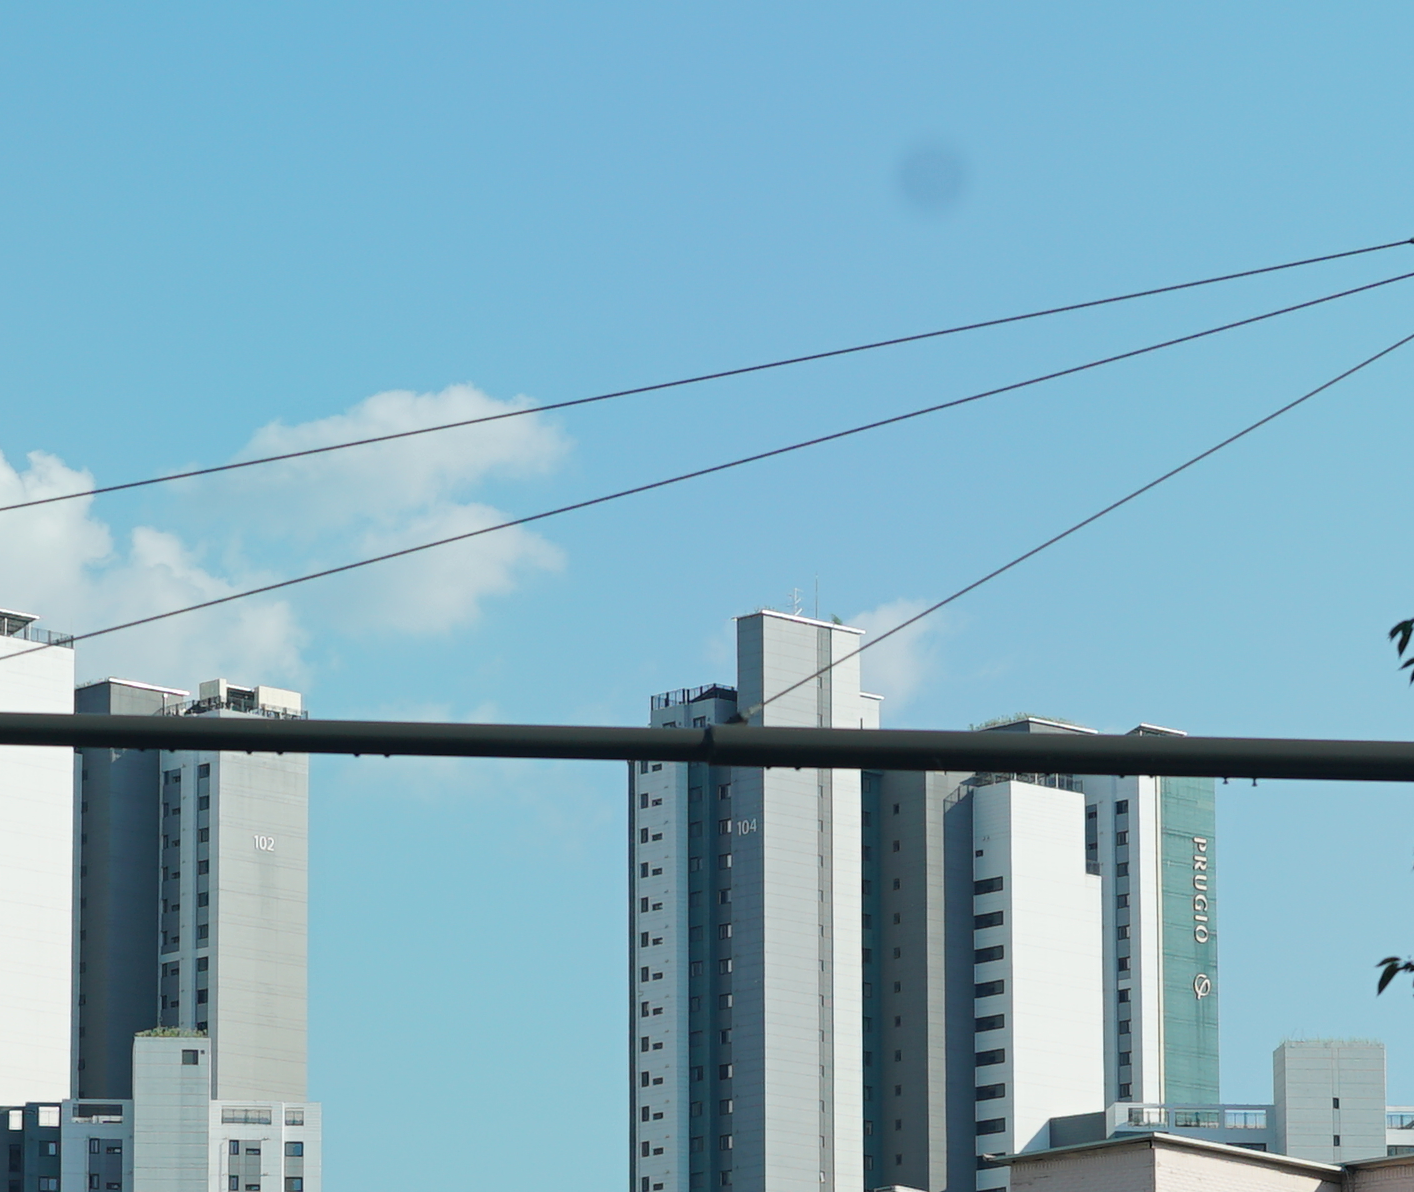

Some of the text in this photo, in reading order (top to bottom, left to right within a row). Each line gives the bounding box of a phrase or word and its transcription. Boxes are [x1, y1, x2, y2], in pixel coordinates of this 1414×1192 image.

[737, 818, 757, 836] 104
[254, 835, 275, 851] 102
[1193, 836, 1209, 943] PRUGIO
